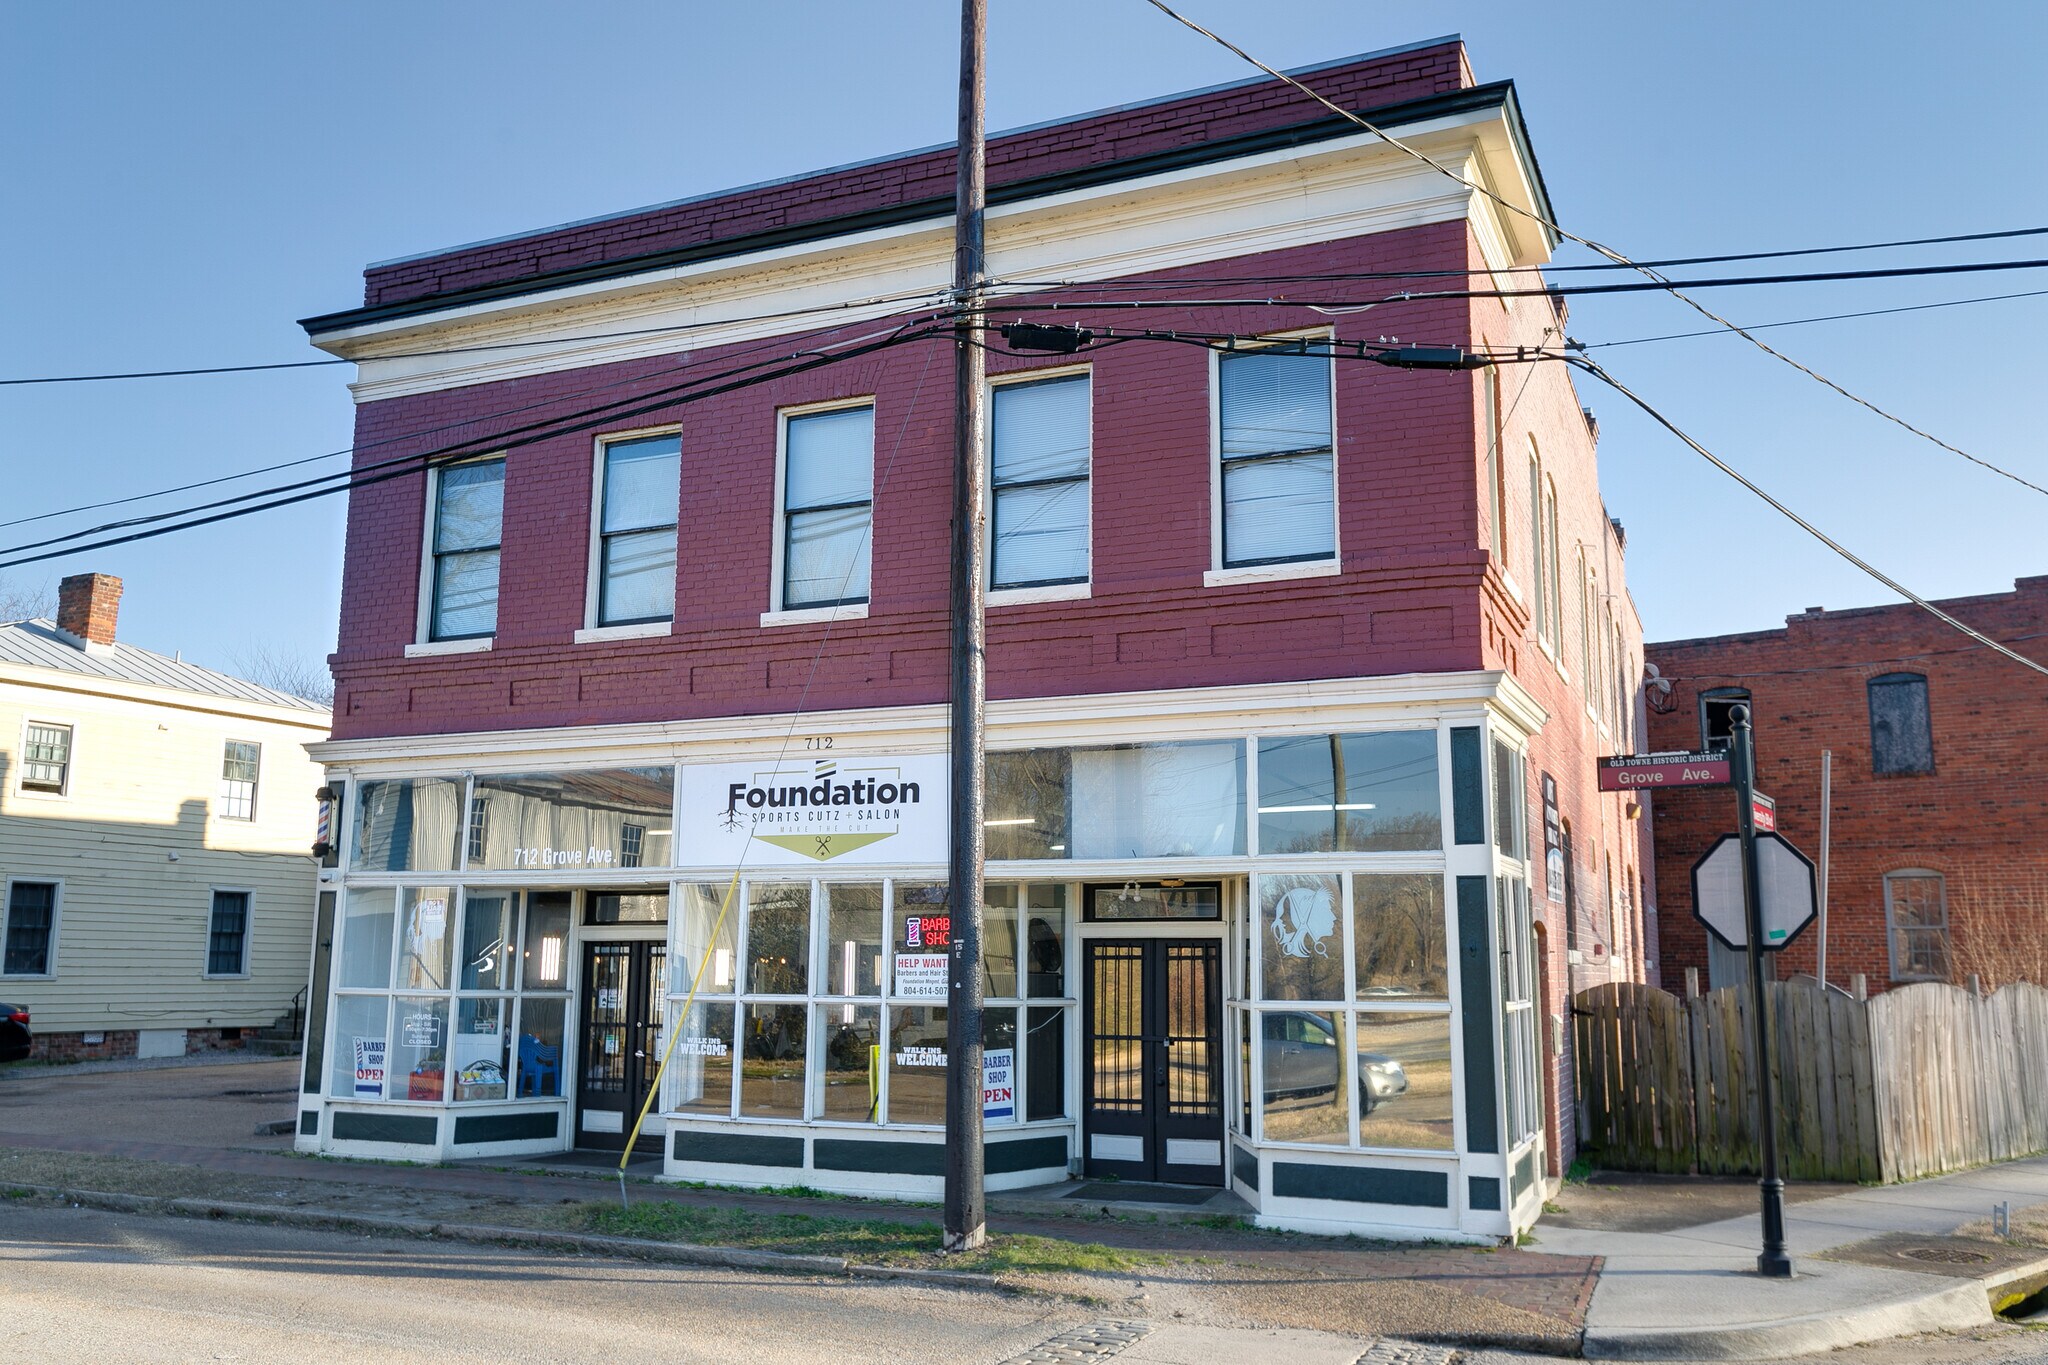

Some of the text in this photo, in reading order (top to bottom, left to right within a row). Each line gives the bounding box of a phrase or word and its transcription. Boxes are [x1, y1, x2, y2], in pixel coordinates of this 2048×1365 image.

[804, 736, 833, 750] 712
[1610, 753, 1724, 768] OLD TOWNE HISTORIC DISTRICT
[1618, 768, 1715, 785] Grove Ave.
[729, 777, 920, 811] Foundation
[752, 811, 800, 823] SPORTS
[808, 810, 840, 822] CUTZ
[858, 808, 901, 821] SALON
[780, 824, 869, 833] MAKE THE CUT
[514, 845, 617, 865] 712 Grove Ave.
[921, 917, 951, 931] BARB
[926, 932, 950, 945] SHO
[898, 958, 948, 968] HELP WANT
[903, 986, 948, 995] 804-614-507
[687, 1037, 721, 1045] WALK INS
[680, 1043, 727, 1056] WELCOME
[902, 1046, 926, 1054] WALK
[368, 1054, 384, 1065] SHOP
[895, 1053, 948, 1067] WELCOME
[983, 1055, 1011, 1069] BARBER
[988, 1071, 1007, 1084] SHOP
[983, 1087, 1012, 1103] PEN
